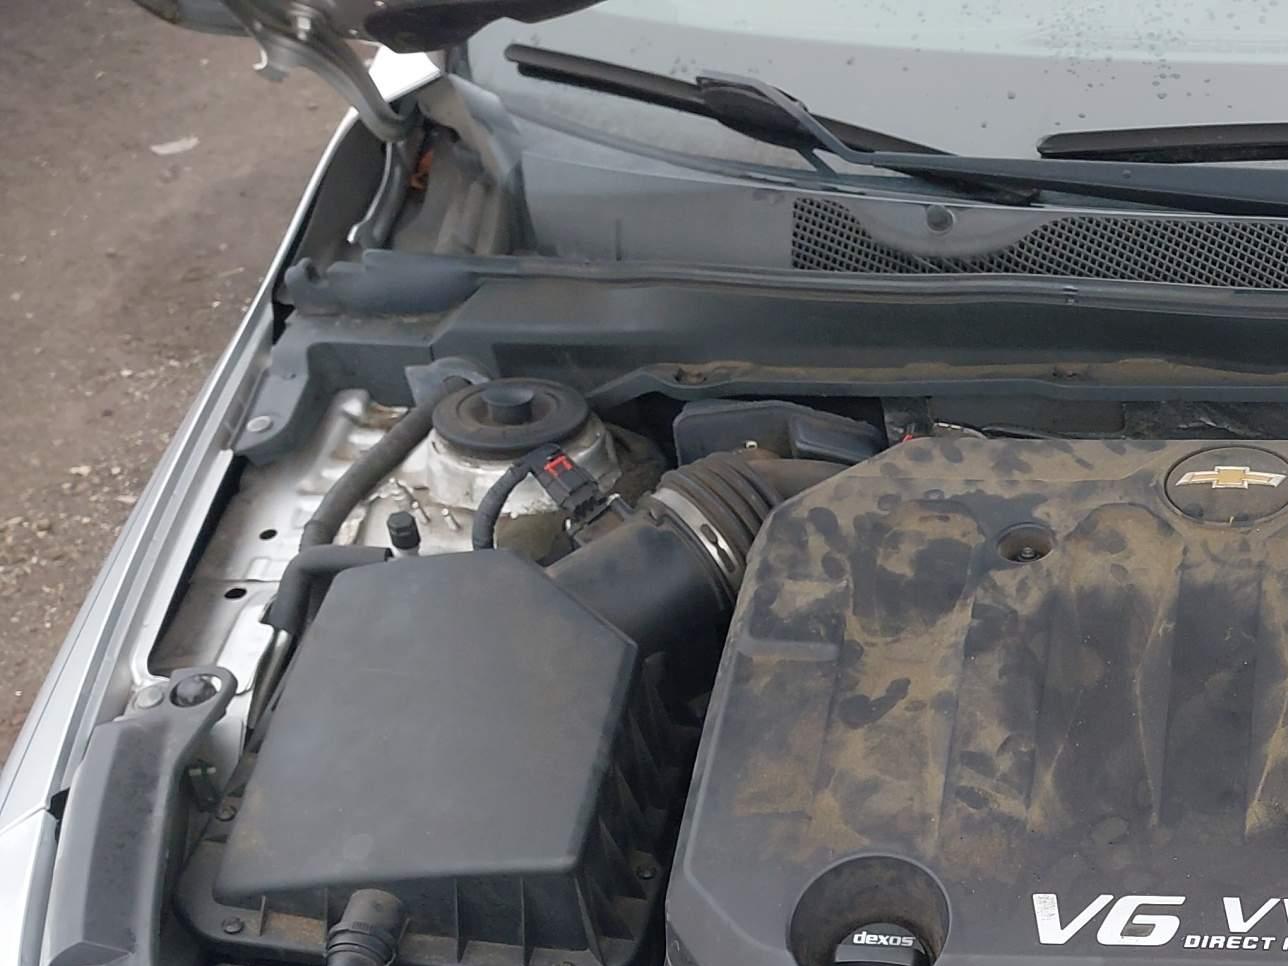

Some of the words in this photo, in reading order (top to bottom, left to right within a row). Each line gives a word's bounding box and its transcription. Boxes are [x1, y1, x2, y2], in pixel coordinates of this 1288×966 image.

[1032, 893, 1186, 946] V6
[853, 931, 916, 946] dexos
[1184, 935, 1275, 949] DIRECT
